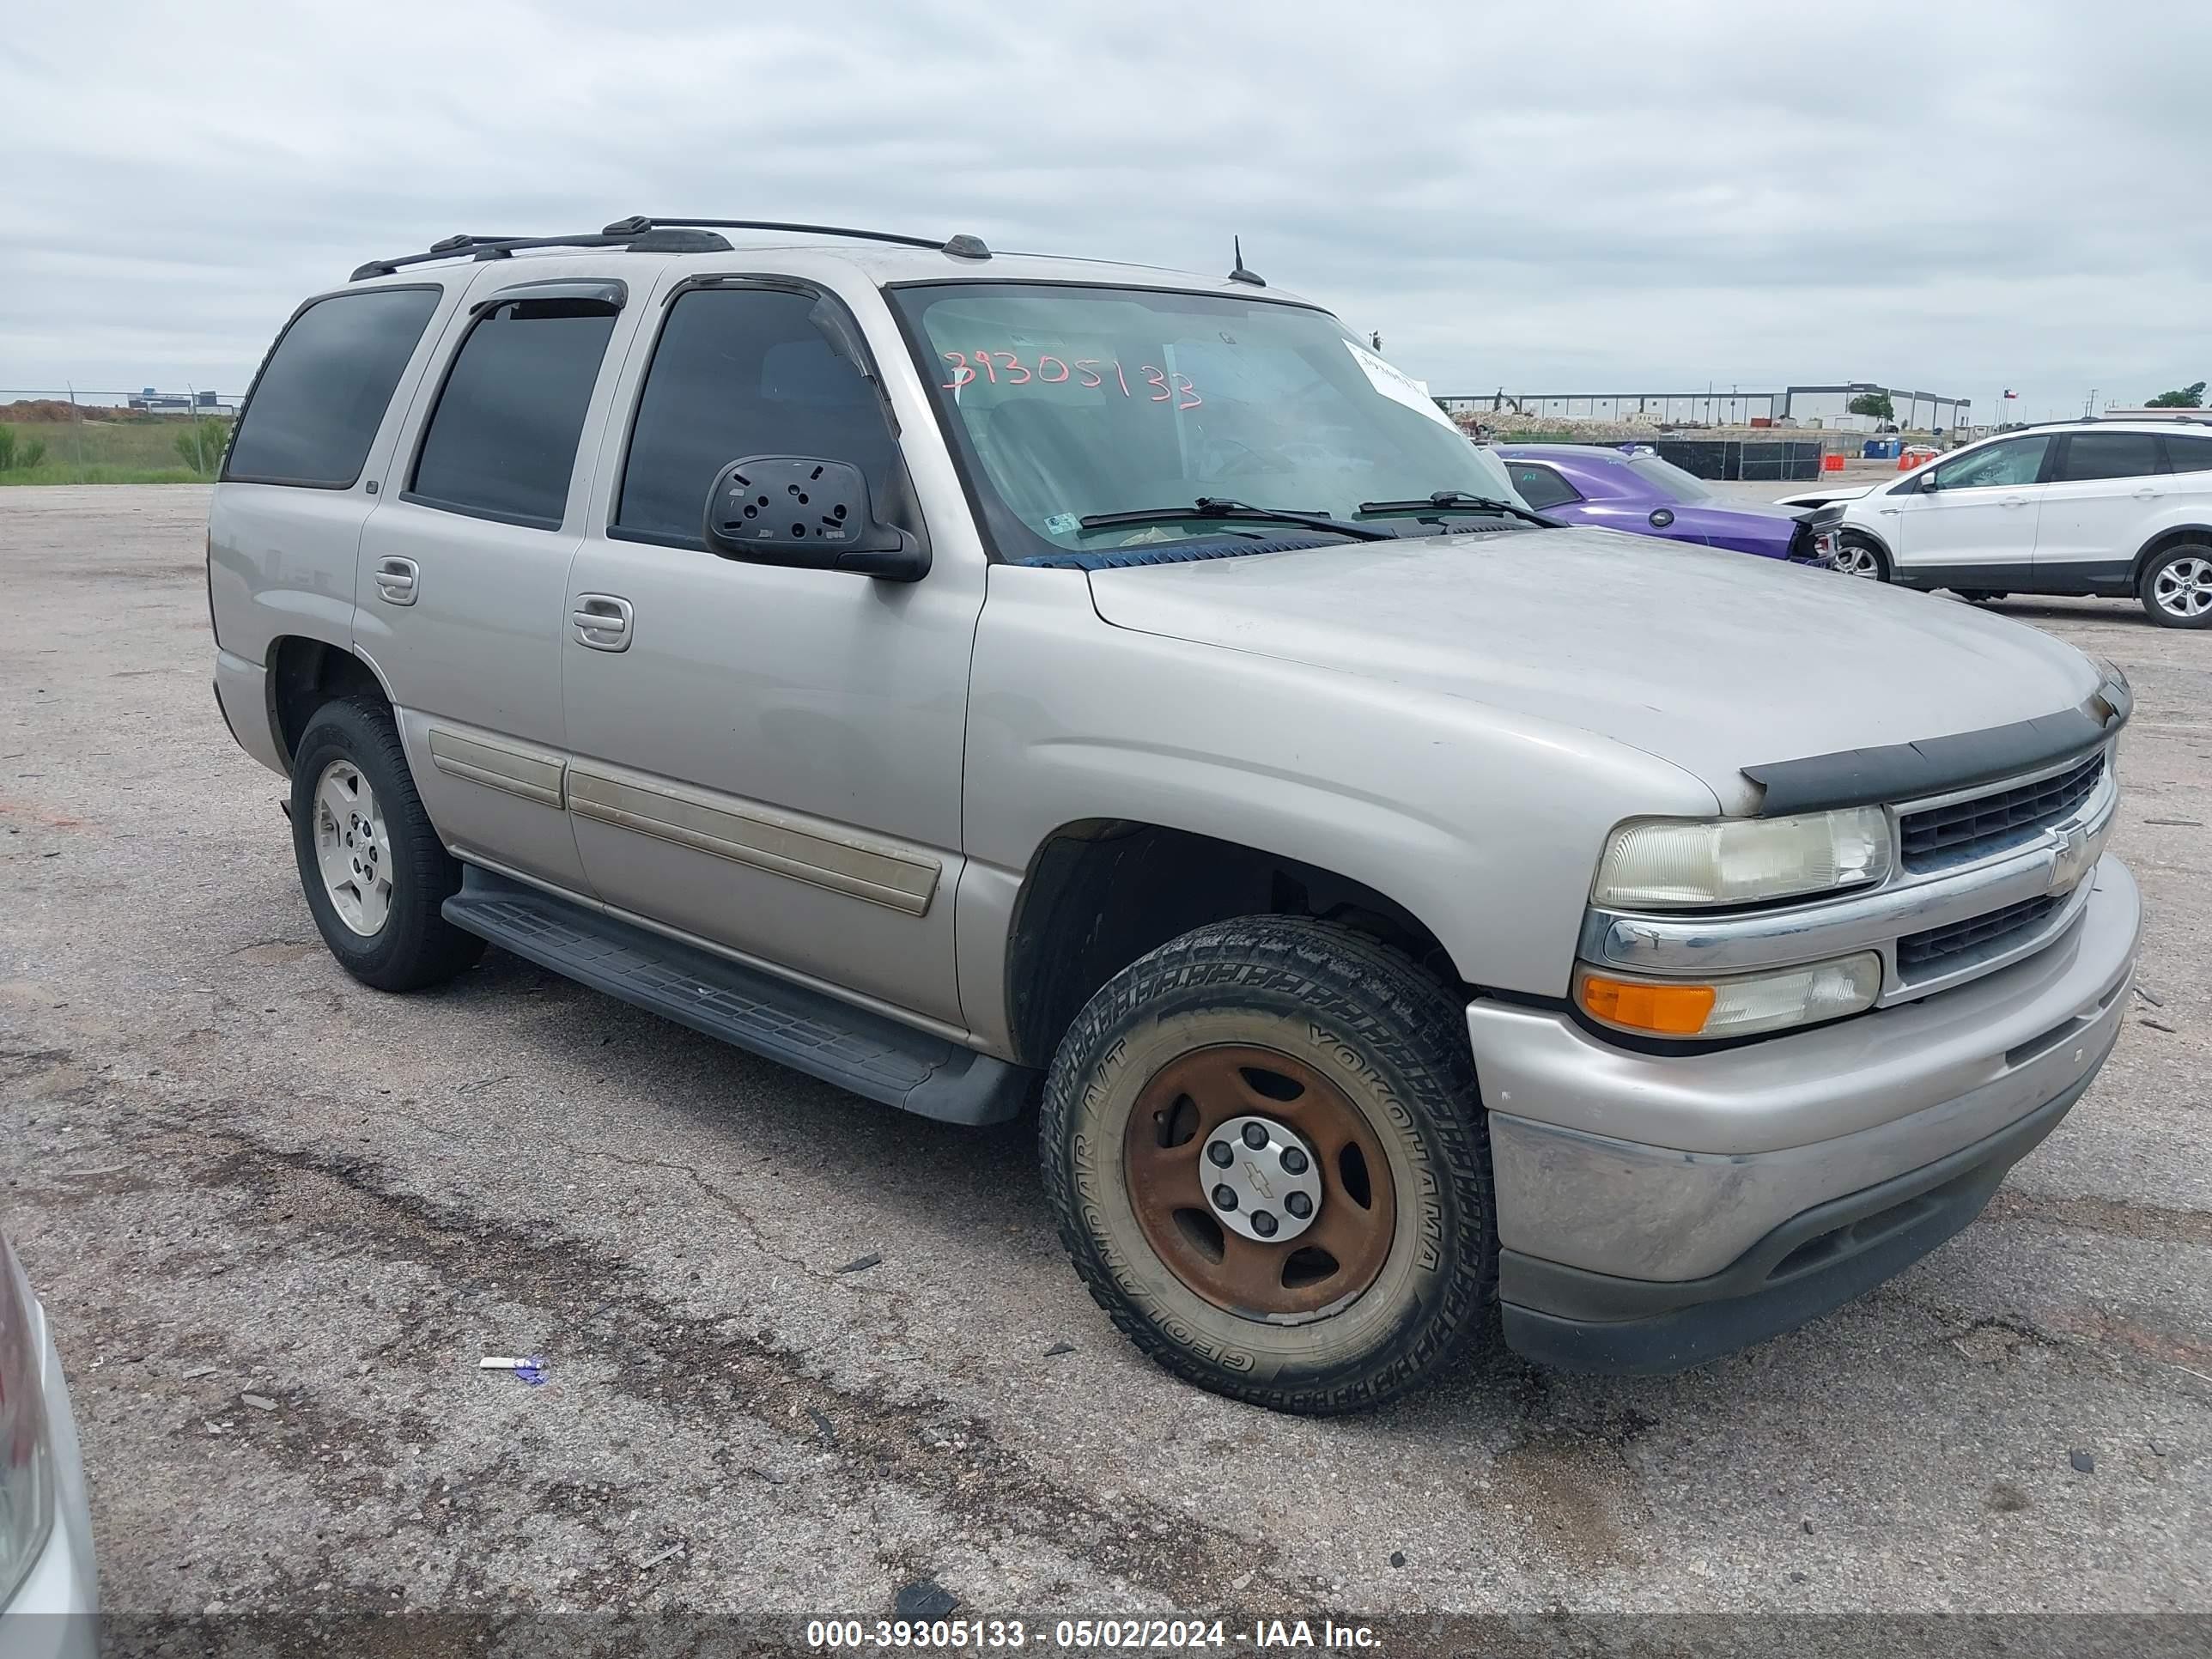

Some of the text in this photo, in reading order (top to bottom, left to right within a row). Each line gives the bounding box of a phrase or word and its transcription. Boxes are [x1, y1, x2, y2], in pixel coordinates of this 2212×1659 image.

[942, 350, 1202, 409] 39305133
[1074, 1037, 1255, 1372] GEOLANDAR A/T
[1308, 1024, 1442, 1273] YOKOHAMA
